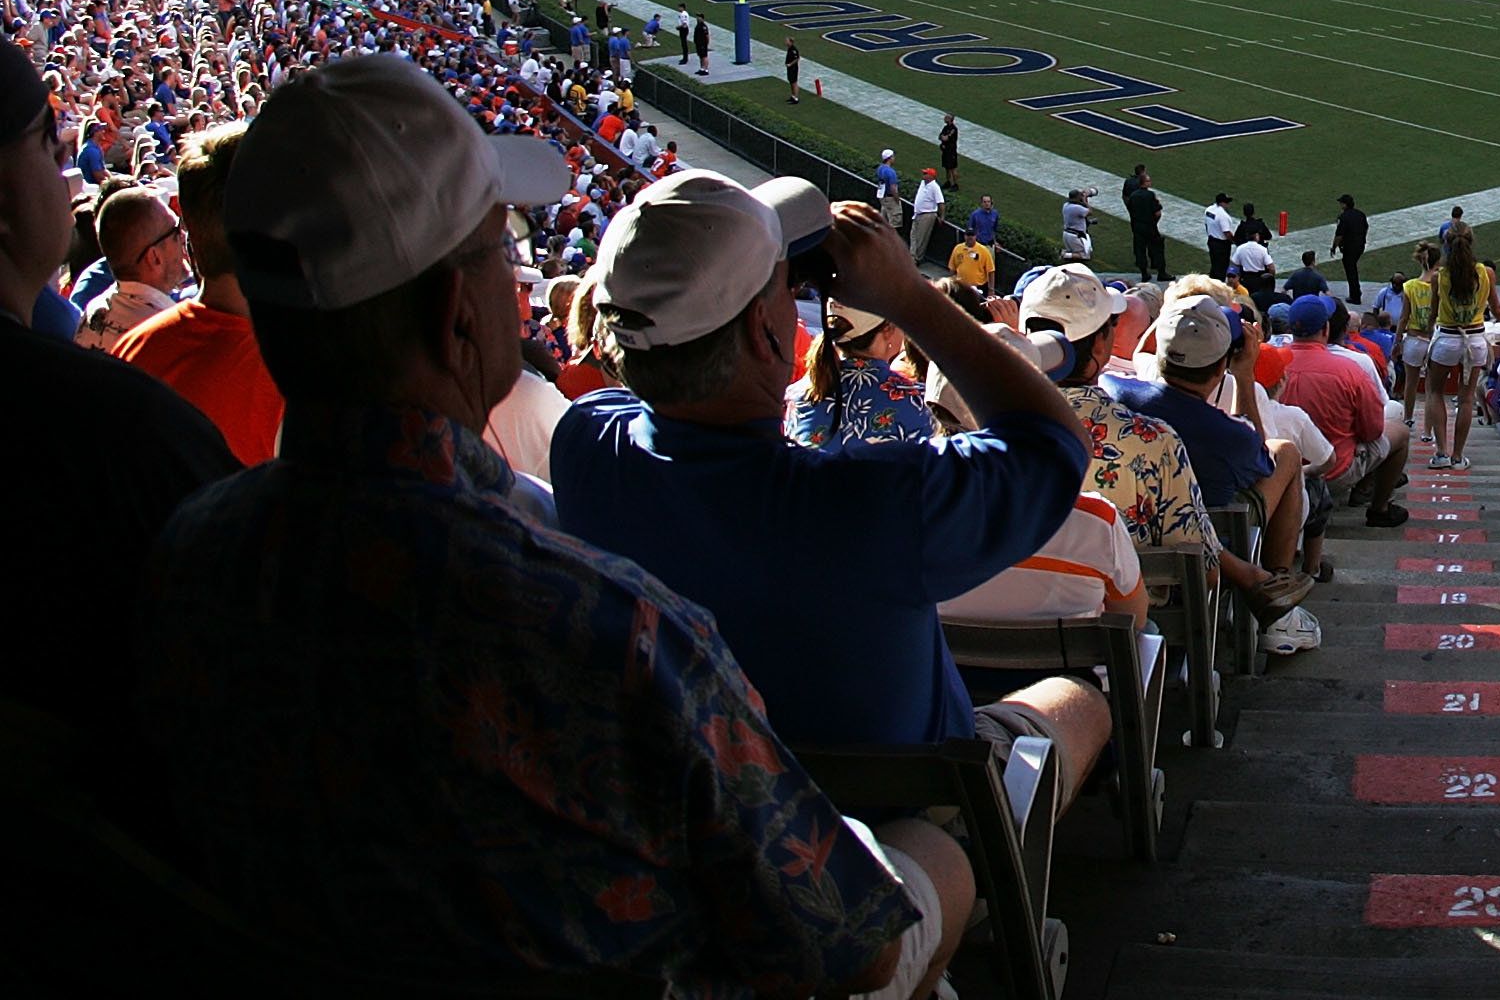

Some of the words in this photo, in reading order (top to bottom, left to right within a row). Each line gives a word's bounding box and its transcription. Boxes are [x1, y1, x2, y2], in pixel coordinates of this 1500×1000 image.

[1437, 533, 1461, 543] 17
[1440, 592, 1468, 605] 19
[1437, 634, 1475, 650] 20
[1442, 692, 1480, 711] 21
[1443, 772, 1497, 798] 22
